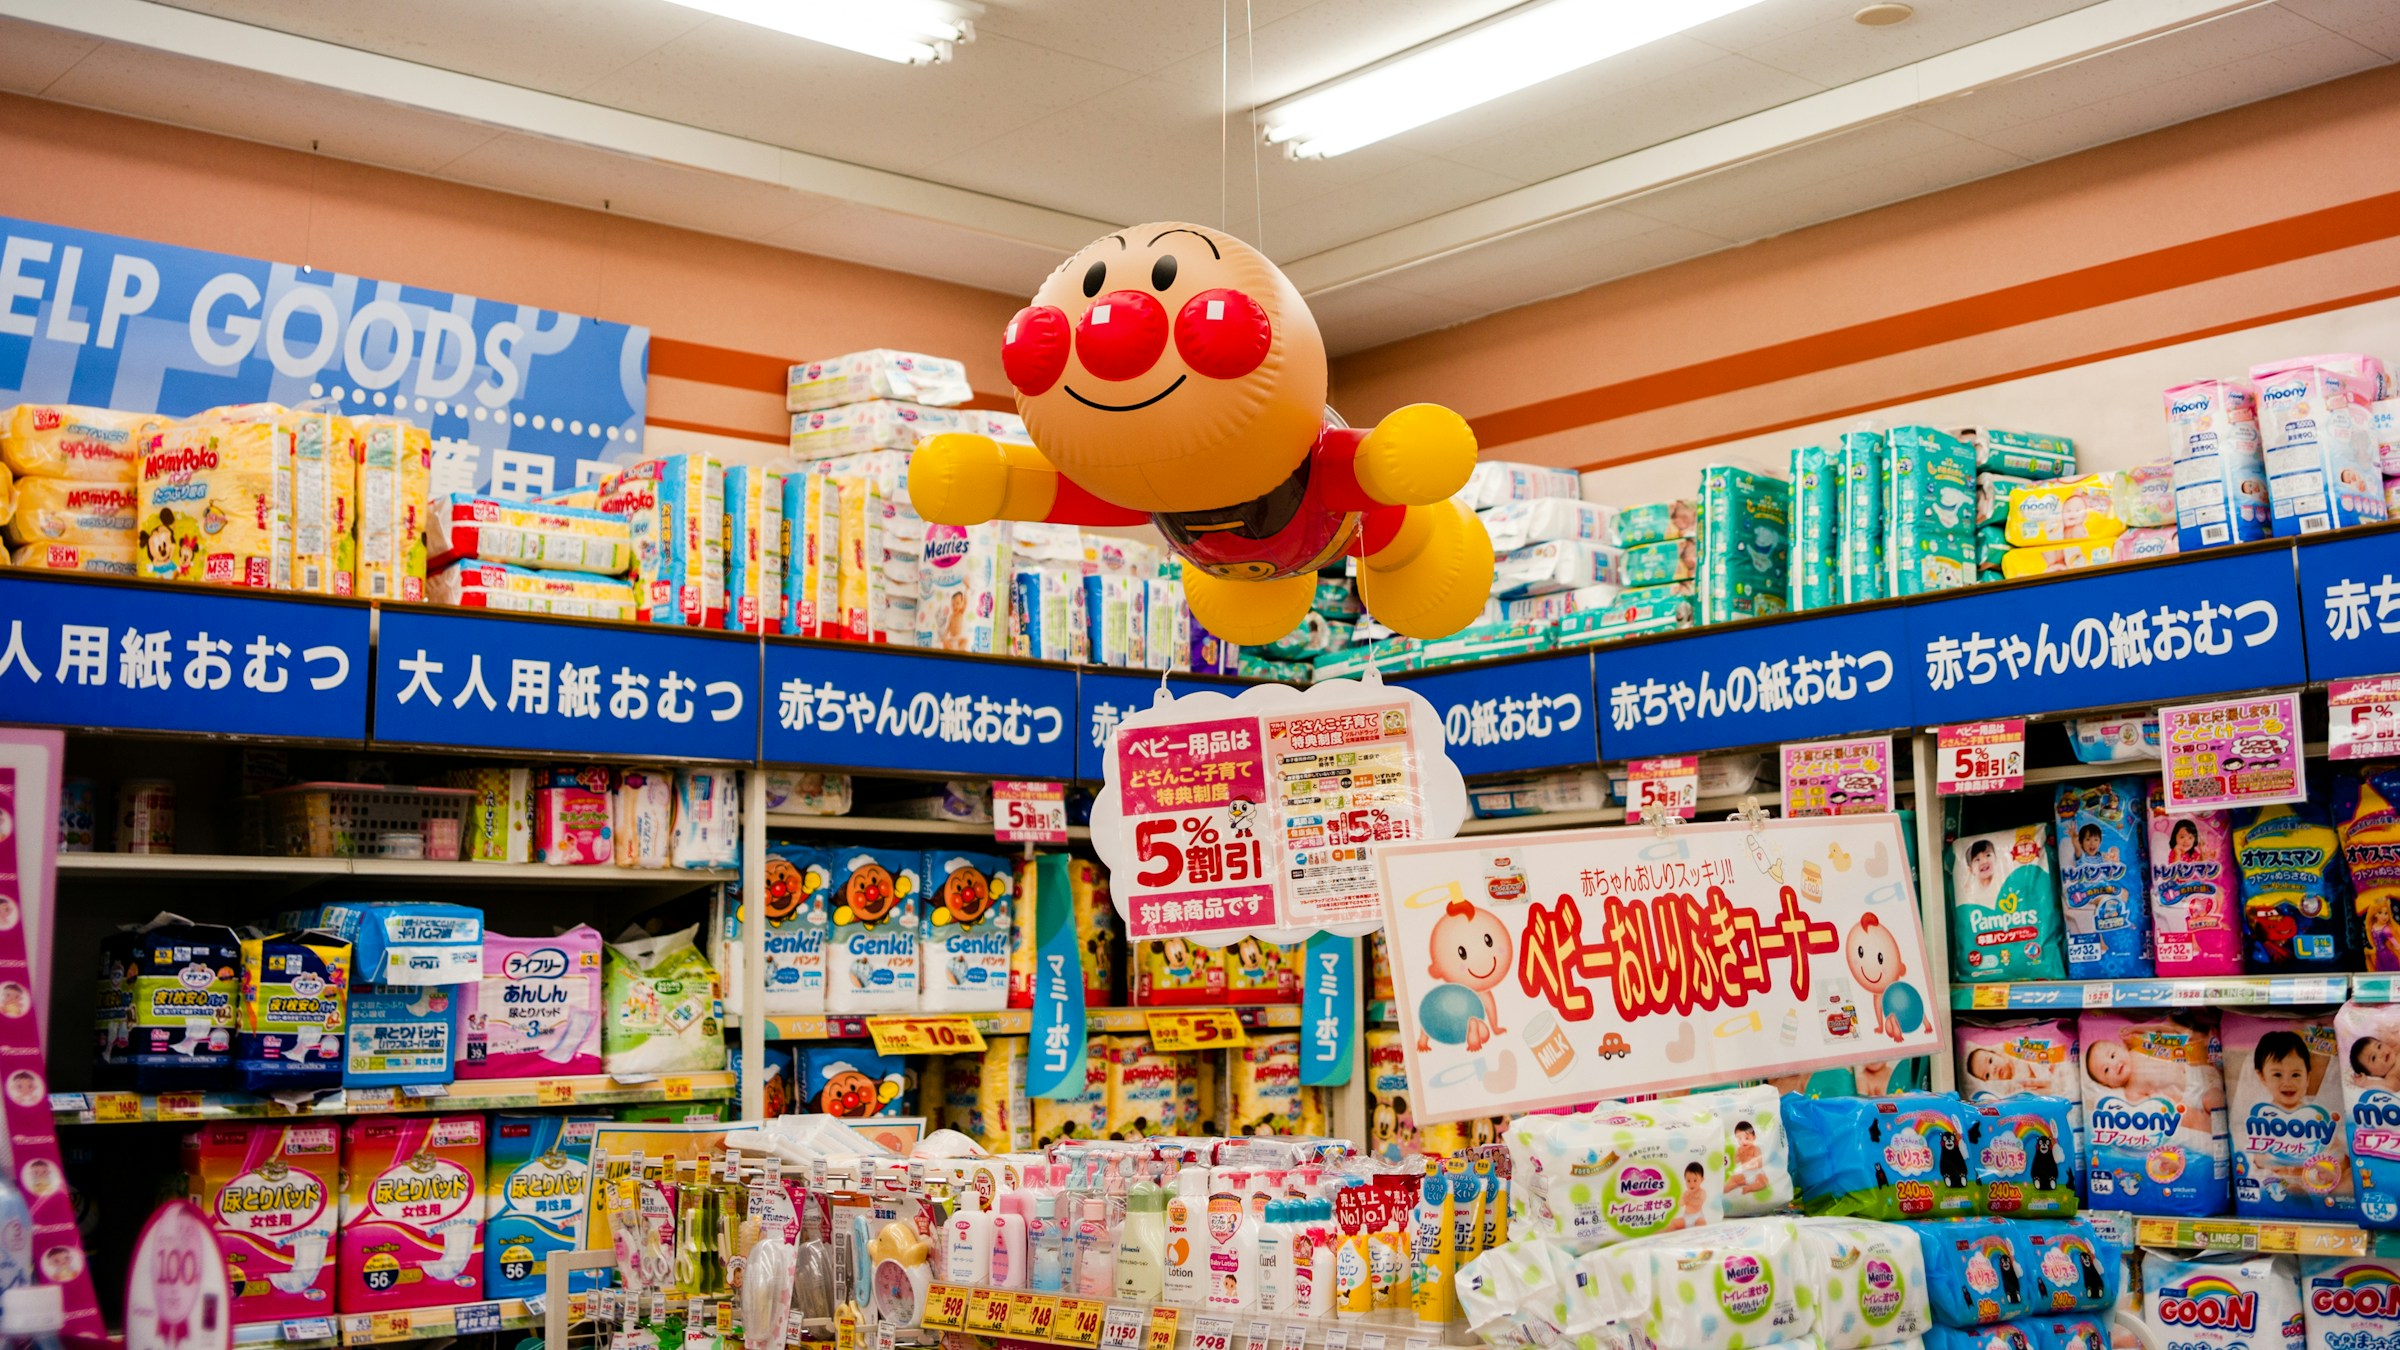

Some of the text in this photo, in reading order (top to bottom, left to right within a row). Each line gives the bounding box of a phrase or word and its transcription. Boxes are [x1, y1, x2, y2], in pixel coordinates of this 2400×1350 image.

[0, 236, 524, 408] ELP GOODS
[2264, 385, 2308, 403] moony
[2171, 399, 2210, 416] moony
[144, 446, 219, 480] MamyPoko
[923, 535, 969, 562] Merries
[1925, 600, 2279, 691] 赤ちゃんの紙おむつ
[0, 619, 350, 694] 人用紙おむつ
[397, 649, 744, 723] 大人用紙おむつ
[1610, 649, 1895, 732] 赤ちゃんの紙おむつ
[778, 677, 1063, 745] 赤ちゃんの紙おむつ
[1445, 691, 1582, 747] の紙おむつ
[1092, 700, 1140, 749] 赤
[1290, 713, 1379, 734] どさんこ・子育て
[1128, 729, 1252, 758] ベビー用品は
[1291, 731, 1345, 750] 特典制度
[1955, 747, 2005, 778] 5%割引
[1130, 761, 1253, 788] どさんこ・子育て
[1156, 782, 1230, 807] 特典制度
[1135, 816, 1262, 888] 5%割引
[2241, 850, 2322, 868] オヤスミマン
[1580, 860, 1735, 897] 赤ちゃんおしりスッキリ!!
[2061, 863, 2126, 882] トレパンマン
[2153, 863, 2220, 880] トレパンマン
[1803, 882, 1821, 896] FOOD
[1140, 894, 1263, 926] 対象商品です
[1970, 908, 2039, 933] Pampers
[765, 930, 822, 954] enki!
[850, 933, 914, 955] Genki!
[945, 934, 1007, 955] Genki!
[2083, 944, 2095, 955] 32
[2173, 944, 2186, 955] 32
[2297, 938, 2312, 957] L
[793, 956, 820, 966] パンツ
[888, 957, 914, 967] パンツ
[981, 956, 1005, 966] パンツ
[1520, 888, 1837, 1018] ベビーおしりふきコーナー
[510, 958, 562, 974] ライフリー
[503, 983, 567, 1004] あんしん
[508, 1007, 561, 1018] 尿とりパッド
[1045, 955, 1071, 1073] マミーポコ
[1316, 953, 1339, 1062] マミーポコ
[374, 1026, 446, 1039] 尿とりパッド
[1538, 1033, 1570, 1070] MILK
[2092, 1109, 2181, 1137] moony
[2246, 1116, 2337, 1146] moony
[2092, 1130, 2150, 1146] エアフィット
[2246, 1136, 2307, 1152] エアフィット
[1883, 1148, 1934, 1168] おしりふき
[1980, 1148, 2027, 1168] おしりふき
[375, 1174, 468, 1203] 尿とりパッド
[975, 1183, 991, 1196] No.1
[1620, 1177, 1665, 1194] Merries
[221, 1183, 321, 1213] 尿とりパッド
[535, 1199, 572, 1212] 男性用
[1341, 1192, 1357, 1208] 売上
[1609, 1199, 1673, 1215] トイレに流せる
[401, 1204, 441, 1219] 女性用
[1339, 1208, 1360, 1226] No.1
[1362, 1206, 1386, 1223] o.1
[1574, 1216, 1585, 1226] 64
[250, 1214, 292, 1229] 女性用
[2209, 1233, 2241, 1244] LINE@
[2314, 1233, 2363, 1248] パンツ
[505, 1262, 525, 1279] 56
[1164, 1258, 1177, 1268] Baby
[1168, 1266, 1193, 1278] Lotion
[1210, 1259, 1239, 1268] Baby Lotion
[1726, 1264, 1760, 1281] Merries
[369, 1271, 389, 1288] 56
[1868, 1271, 1894, 1284] Merries
[1723, 1283, 1769, 1302] トイレに流せる
[944, 1297, 963, 1317] 598
[987, 1301, 1008, 1322] 598
[1031, 1306, 1052, 1327] 748
[1076, 1311, 1098, 1333] 748
[1109, 1325, 1137, 1340] 1150
[1153, 1331, 1170, 1344] 798
[1196, 1335, 1226, 1350] 798
